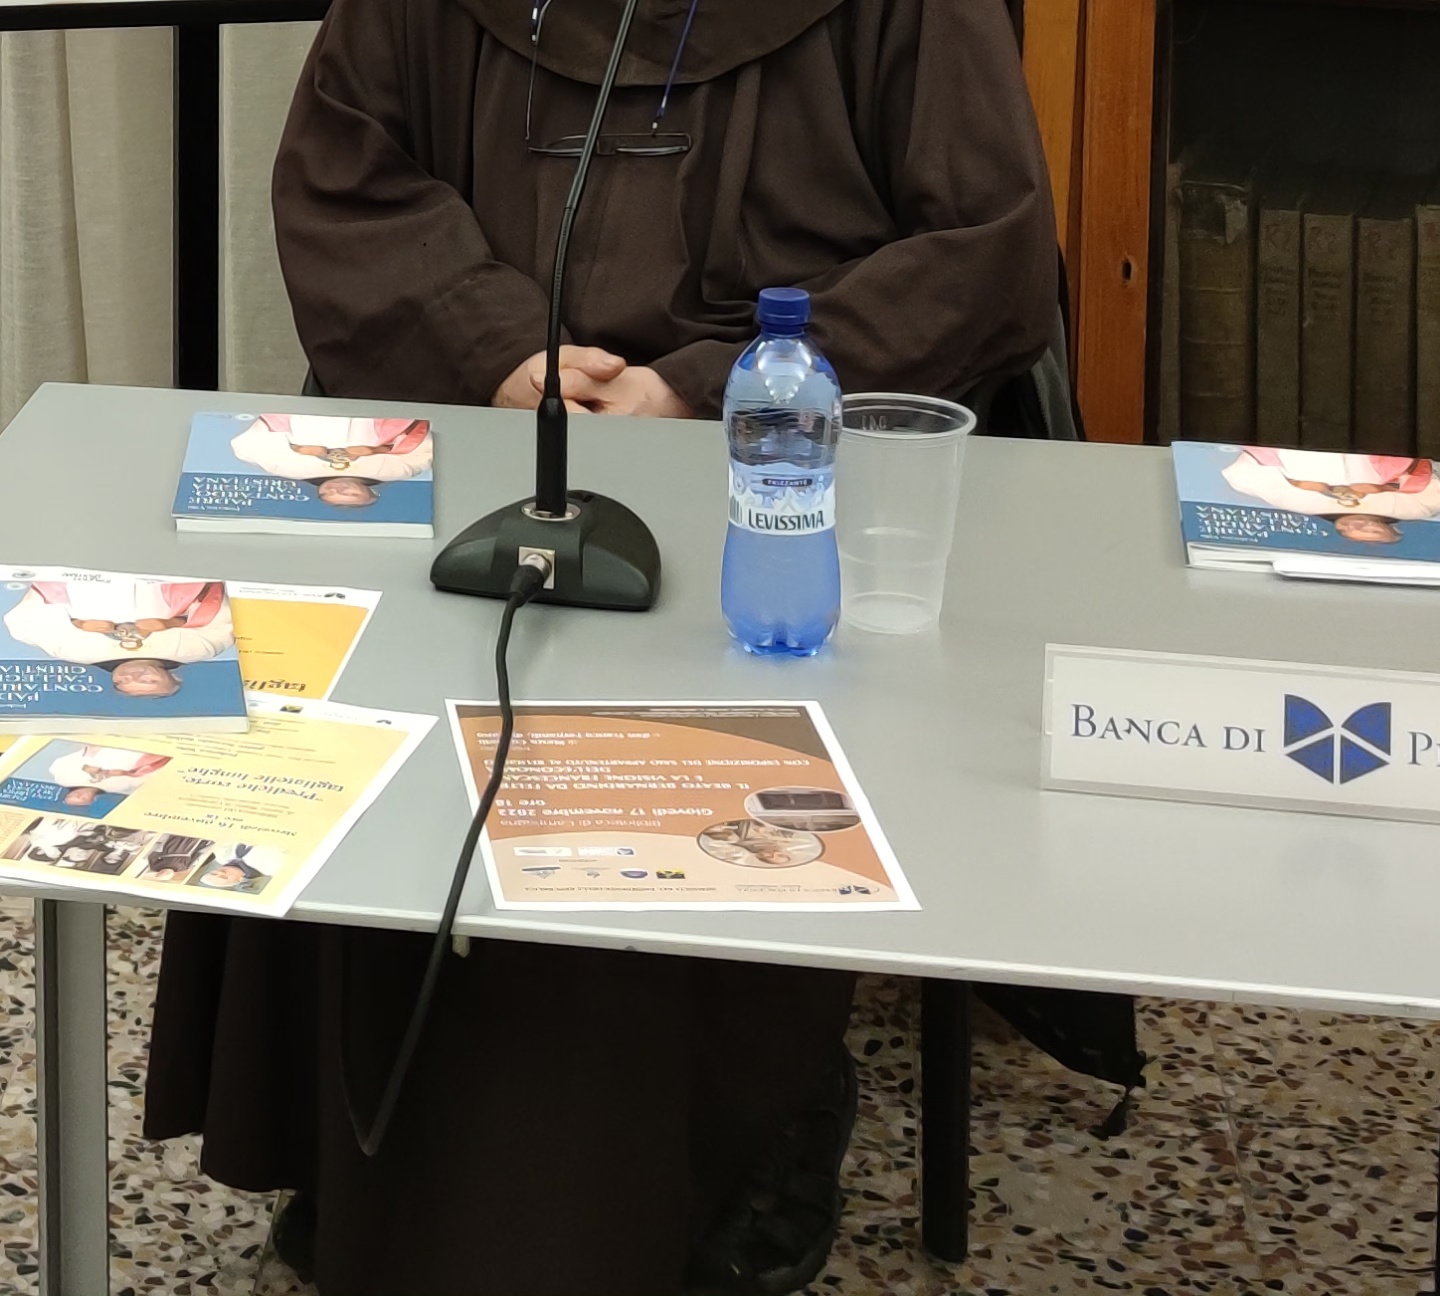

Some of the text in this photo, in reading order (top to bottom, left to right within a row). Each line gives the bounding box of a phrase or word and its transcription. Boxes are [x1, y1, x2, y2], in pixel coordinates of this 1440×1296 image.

[747, 508, 825, 531] LEVISSIMA
[1069, 701, 1207, 750] BANCA
[1222, 725, 1266, 753] DI
[253, 773, 345, 793] tagliatelle
[518, 798, 547, 807] ore
[143, 811, 214, 826] novembre
[498, 807, 714, 817] Giovedì 17 novembre 2022
